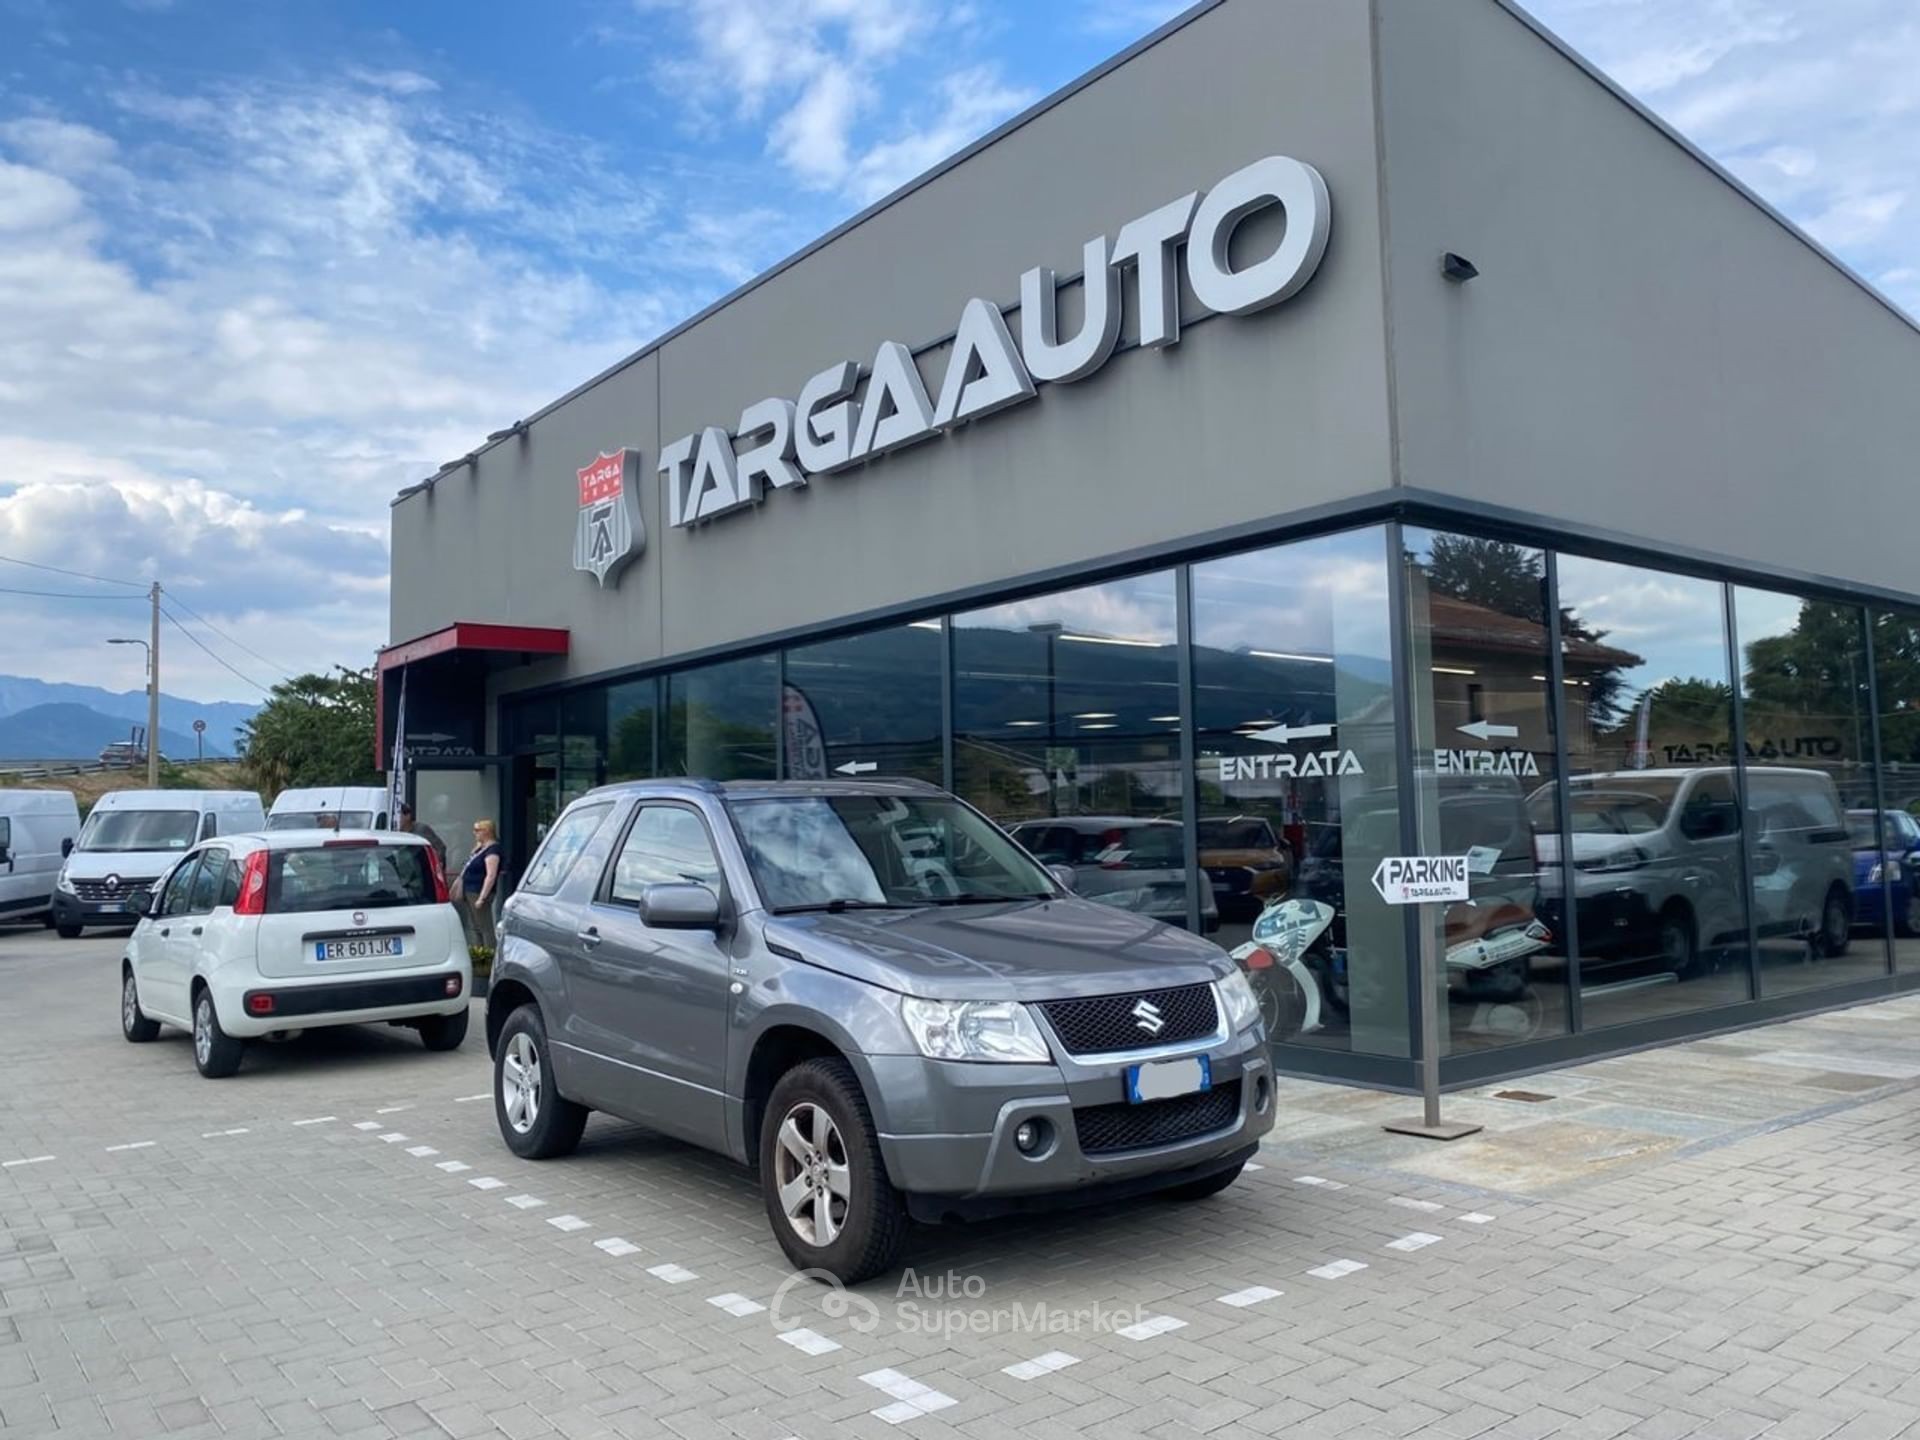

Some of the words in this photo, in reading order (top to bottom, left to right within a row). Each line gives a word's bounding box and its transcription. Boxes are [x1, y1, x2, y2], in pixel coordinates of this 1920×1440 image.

[583, 463, 620, 488] TARGA
[1219, 749, 1364, 781] ENTRATA
[1434, 748, 1540, 776] ENTRATA
[1390, 858, 1465, 884] PARKING
[327, 943, 345, 959] ER
